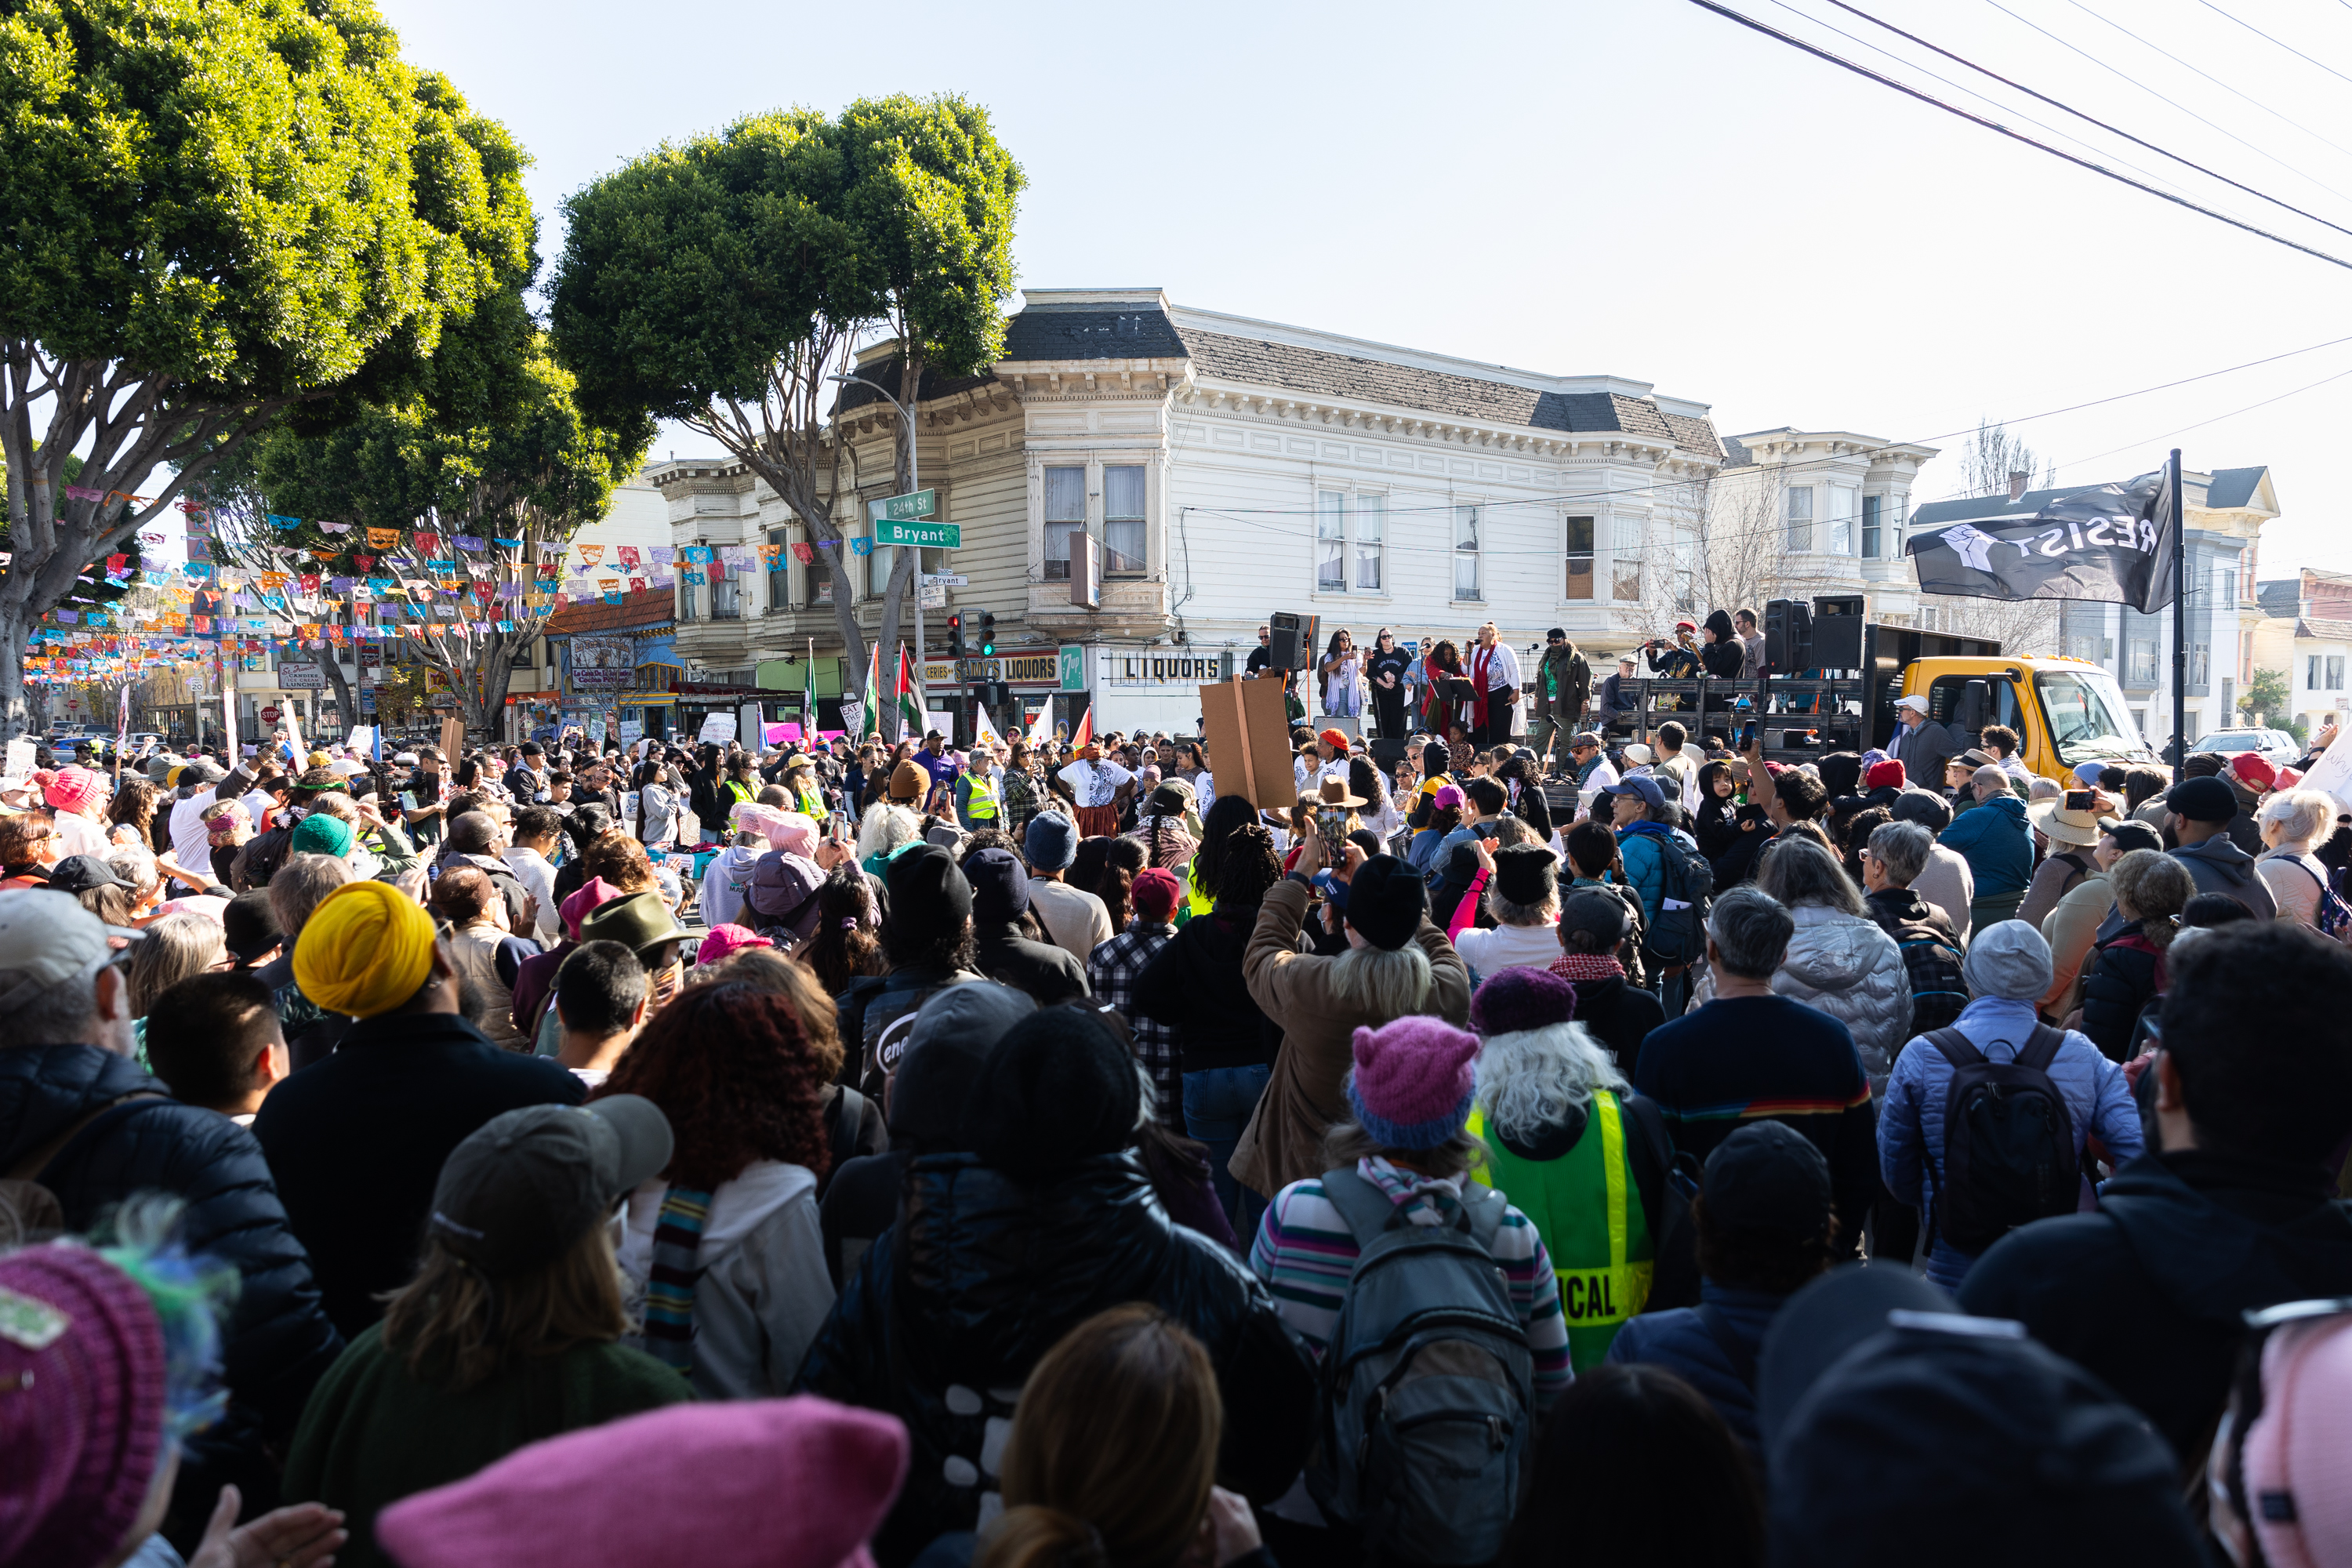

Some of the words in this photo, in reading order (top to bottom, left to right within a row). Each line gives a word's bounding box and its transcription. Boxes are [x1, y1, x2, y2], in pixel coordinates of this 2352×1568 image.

[894, 501, 913, 516] 24th
[917, 497, 927, 510] St
[894, 526, 944, 543] Bryant
[575, 644, 584, 653] La
[1005, 656, 1055, 681] LIQUORS
[1125, 659, 1218, 684] LIQUORS
[841, 704, 857, 715] EAT
[845, 711, 860, 723] THE
